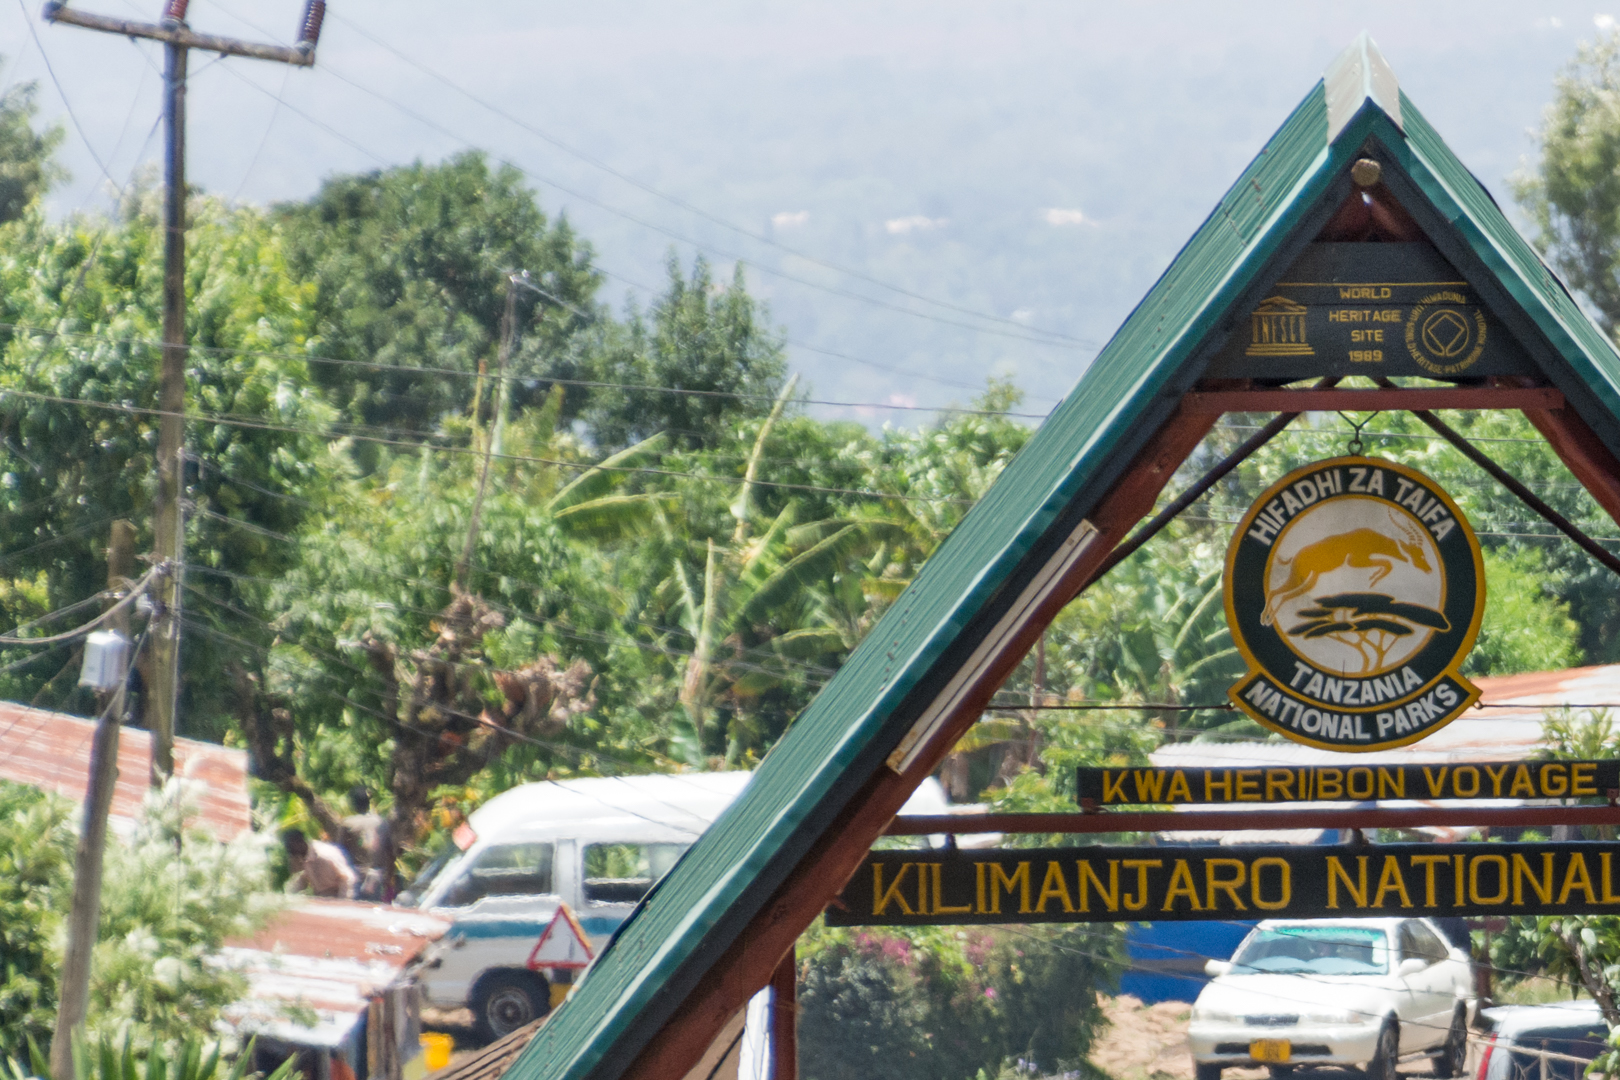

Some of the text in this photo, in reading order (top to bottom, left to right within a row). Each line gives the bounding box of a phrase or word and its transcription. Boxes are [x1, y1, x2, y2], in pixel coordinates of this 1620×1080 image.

[1339, 287, 1392, 299] WORLD
[1328, 309, 1403, 322] HERITAGE
[1351, 329, 1384, 342] SITE
[1348, 349, 1383, 362] 1989
[1248, 468, 1456, 546] HIFADHI ZA TAIFA
[1290, 661, 1423, 704] TANZANIA
[1244, 681, 1458, 740] NATIONAL PARKS
[1422, 762, 1598, 799] VOYAGE
[871, 857, 1291, 916] KILIMANJARO
